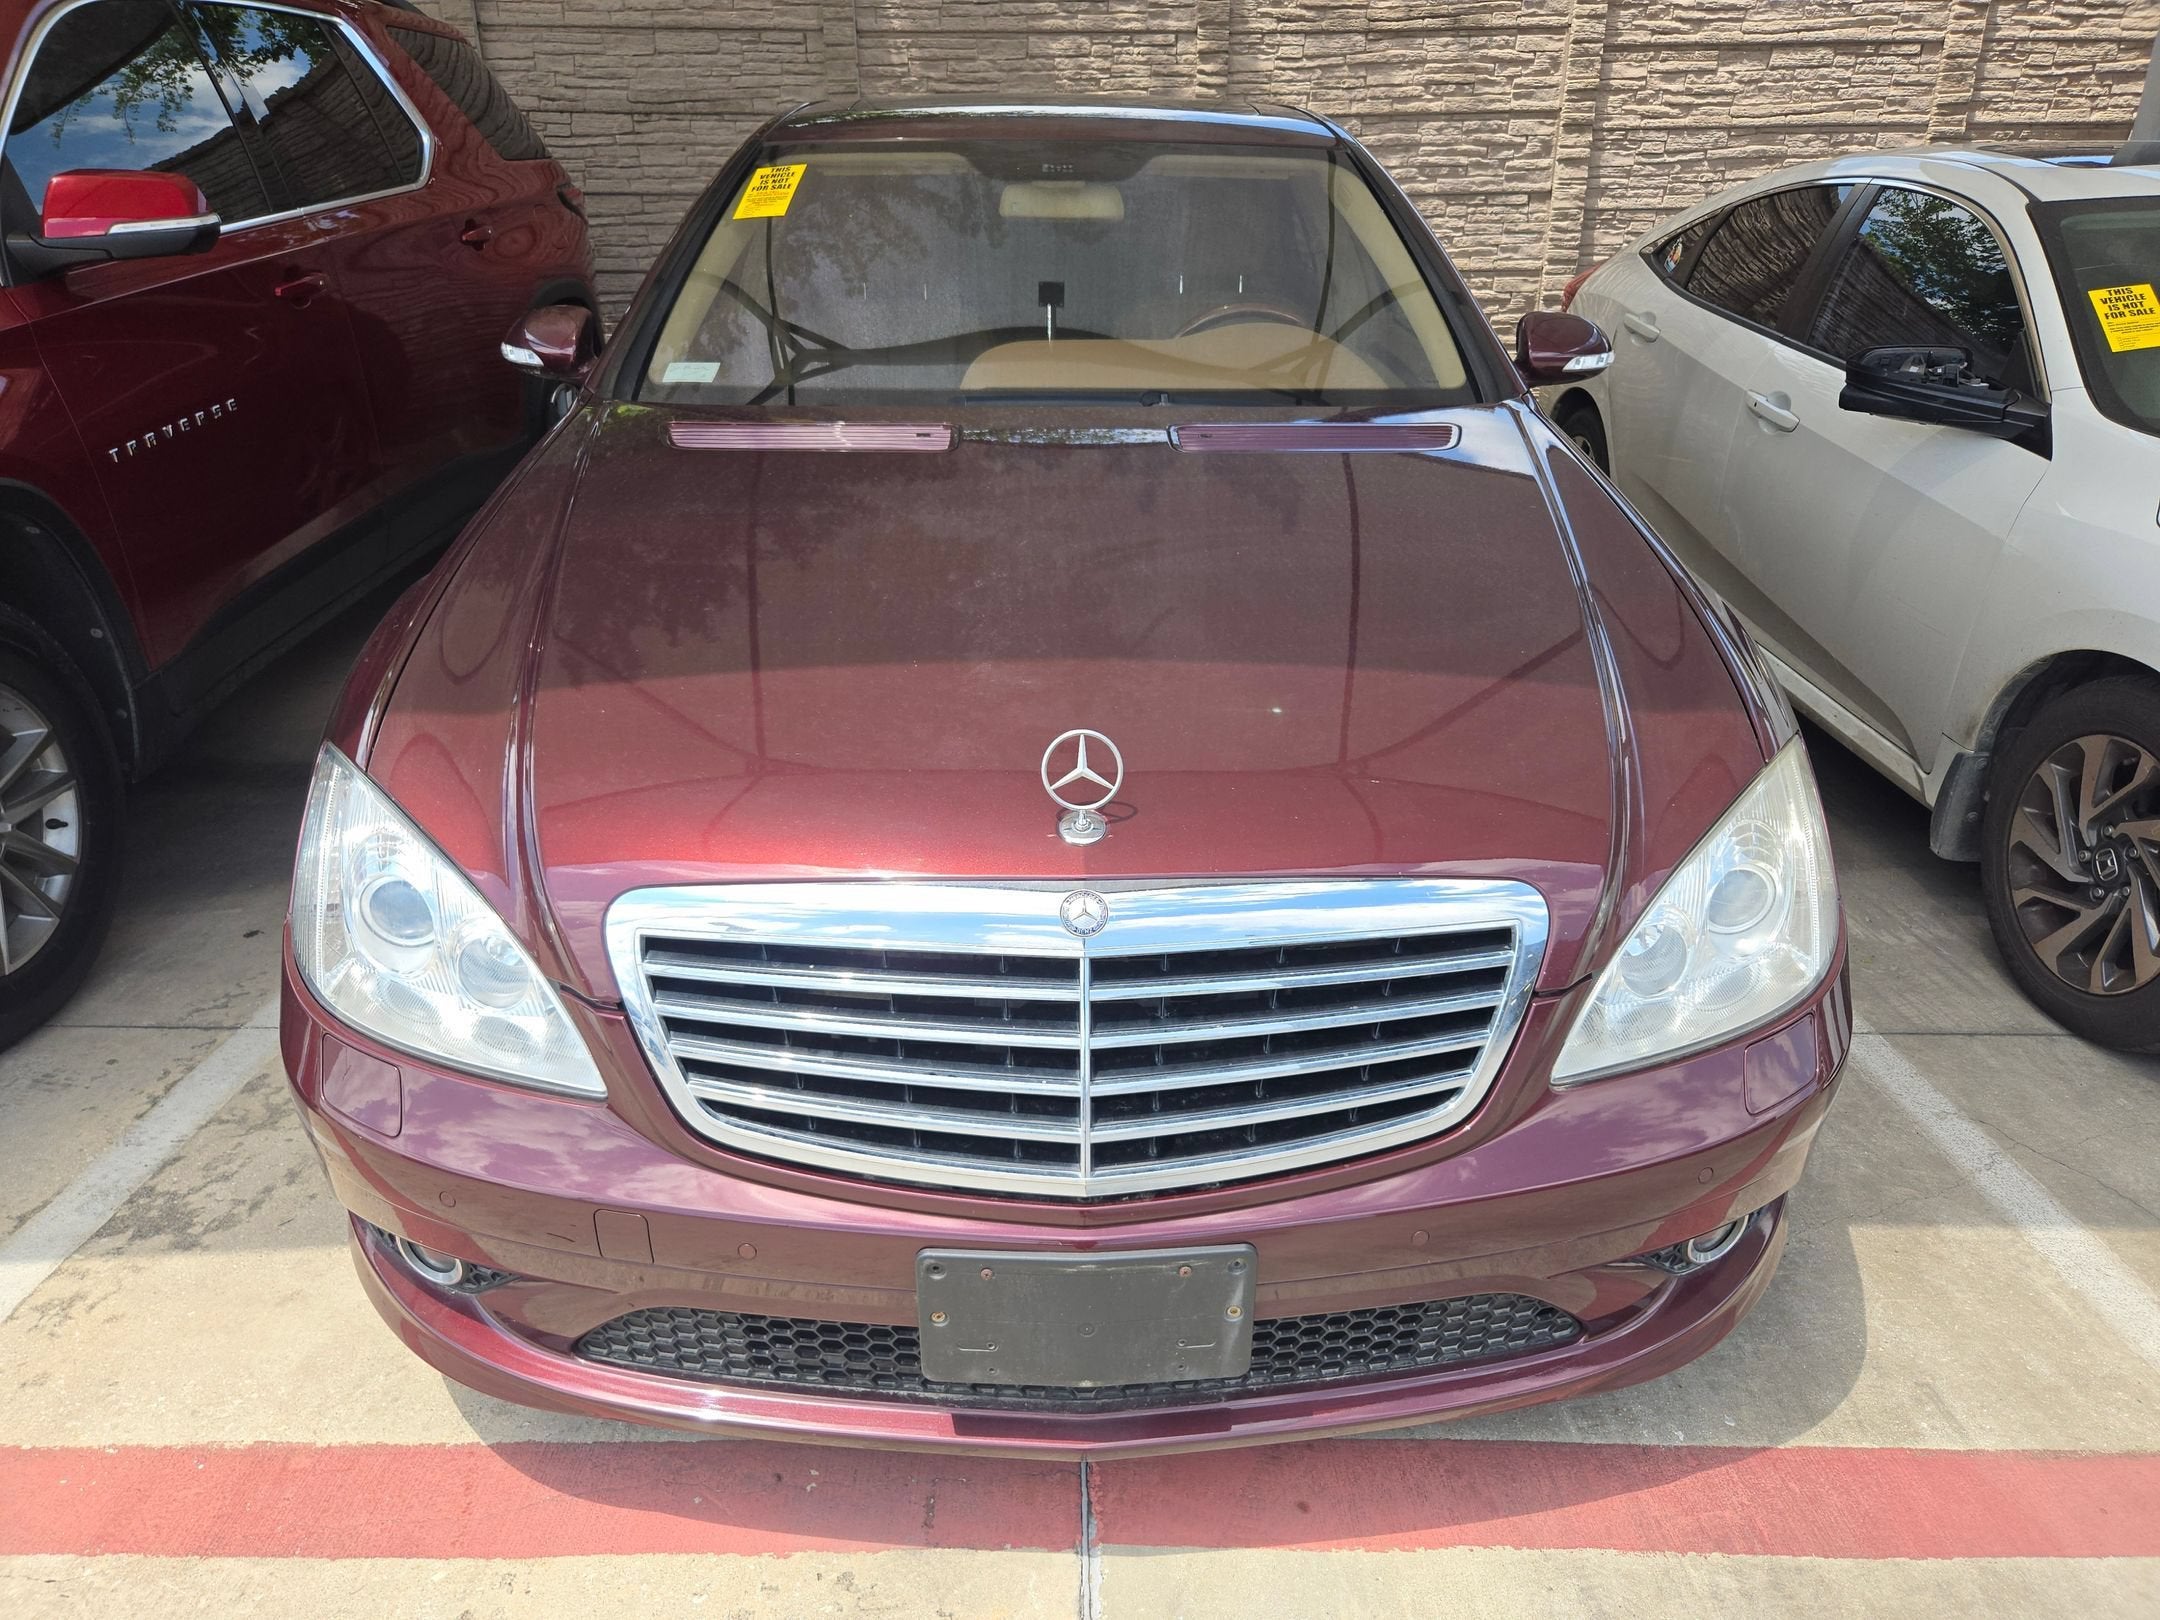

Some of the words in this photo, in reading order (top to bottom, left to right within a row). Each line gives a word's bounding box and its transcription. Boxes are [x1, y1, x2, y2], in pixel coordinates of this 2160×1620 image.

[759, 171, 796, 179] VEHICLE
[2106, 287, 2134, 297] THIS
[2100, 293, 2147, 305] VEHICLE
[2108, 303, 2120, 311] IS
[2122, 301, 2145, 310] NOT
[2104, 311, 2127, 320] FOR
[2128, 307, 2156, 317] SALE
[108, 398, 238, 463] TRAVERSE
